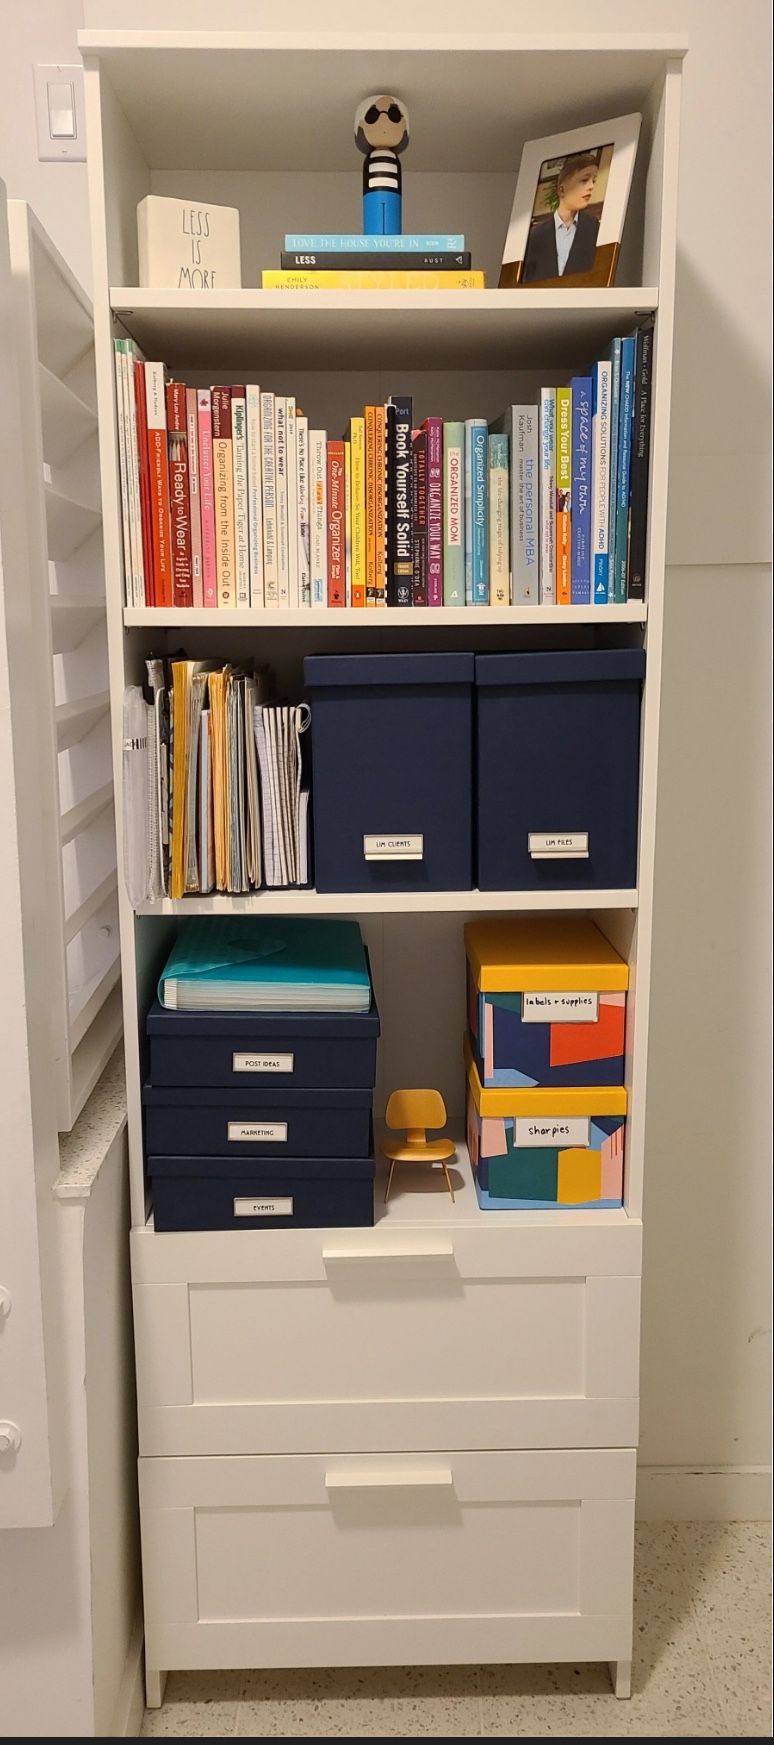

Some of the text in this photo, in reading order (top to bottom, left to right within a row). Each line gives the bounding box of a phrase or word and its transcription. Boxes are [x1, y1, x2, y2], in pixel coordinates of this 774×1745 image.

[183, 209, 210, 237] LESS
[192, 239, 201, 265] IS
[293, 238, 316, 248] LOVE
[320, 238, 337, 248] THE
[340, 238, 370, 248] HOUSE
[373, 238, 404, 248] YOU'RE
[409, 238, 419, 248] IN
[295, 255, 316, 264] LESS
[641, 334, 649, 363] Wolfman
[212, 391, 221, 437] Morgenstern
[222, 392, 230, 410] Julie
[234, 405, 244, 440] Kiplinger's
[576, 401, 589, 443] space
[264, 432, 274, 442] FOR
[264, 445, 274, 455] THE
[278, 446, 284, 455] to
[560, 399, 569, 480] Dress Your Best
[576, 444, 586, 454] of
[638, 424, 646, 458] Everything
[236, 444, 244, 472] Taming
[264, 457, 274, 484] CREATIVE
[474, 435, 485, 482] Organized
[574, 458, 587, 481] my
[174, 463, 187, 505] Ready
[331, 460, 340, 509] One-Minute
[396, 424, 410, 556] Book Yourself Solid
[177, 506, 184, 516] to
[236, 488, 244, 510] Paper
[450, 458, 458, 542] ORGANIZED MOM
[474, 484, 485, 527] Simplicity
[524, 459, 534, 566] the personal MBA
[579, 485, 588, 514] own
[218, 441, 230, 587] Organizing from the Inside Out
[236, 514, 246, 534] Tiger
[430, 483, 441, 559] ORGANIZE YOUR WAY
[176, 516, 188, 550] Wear
[330, 510, 342, 562] Organizer
[526, 997, 551, 1006] labels
[561, 998, 592, 1007] supplies
[528, 1124, 570, 1137] sharpies
